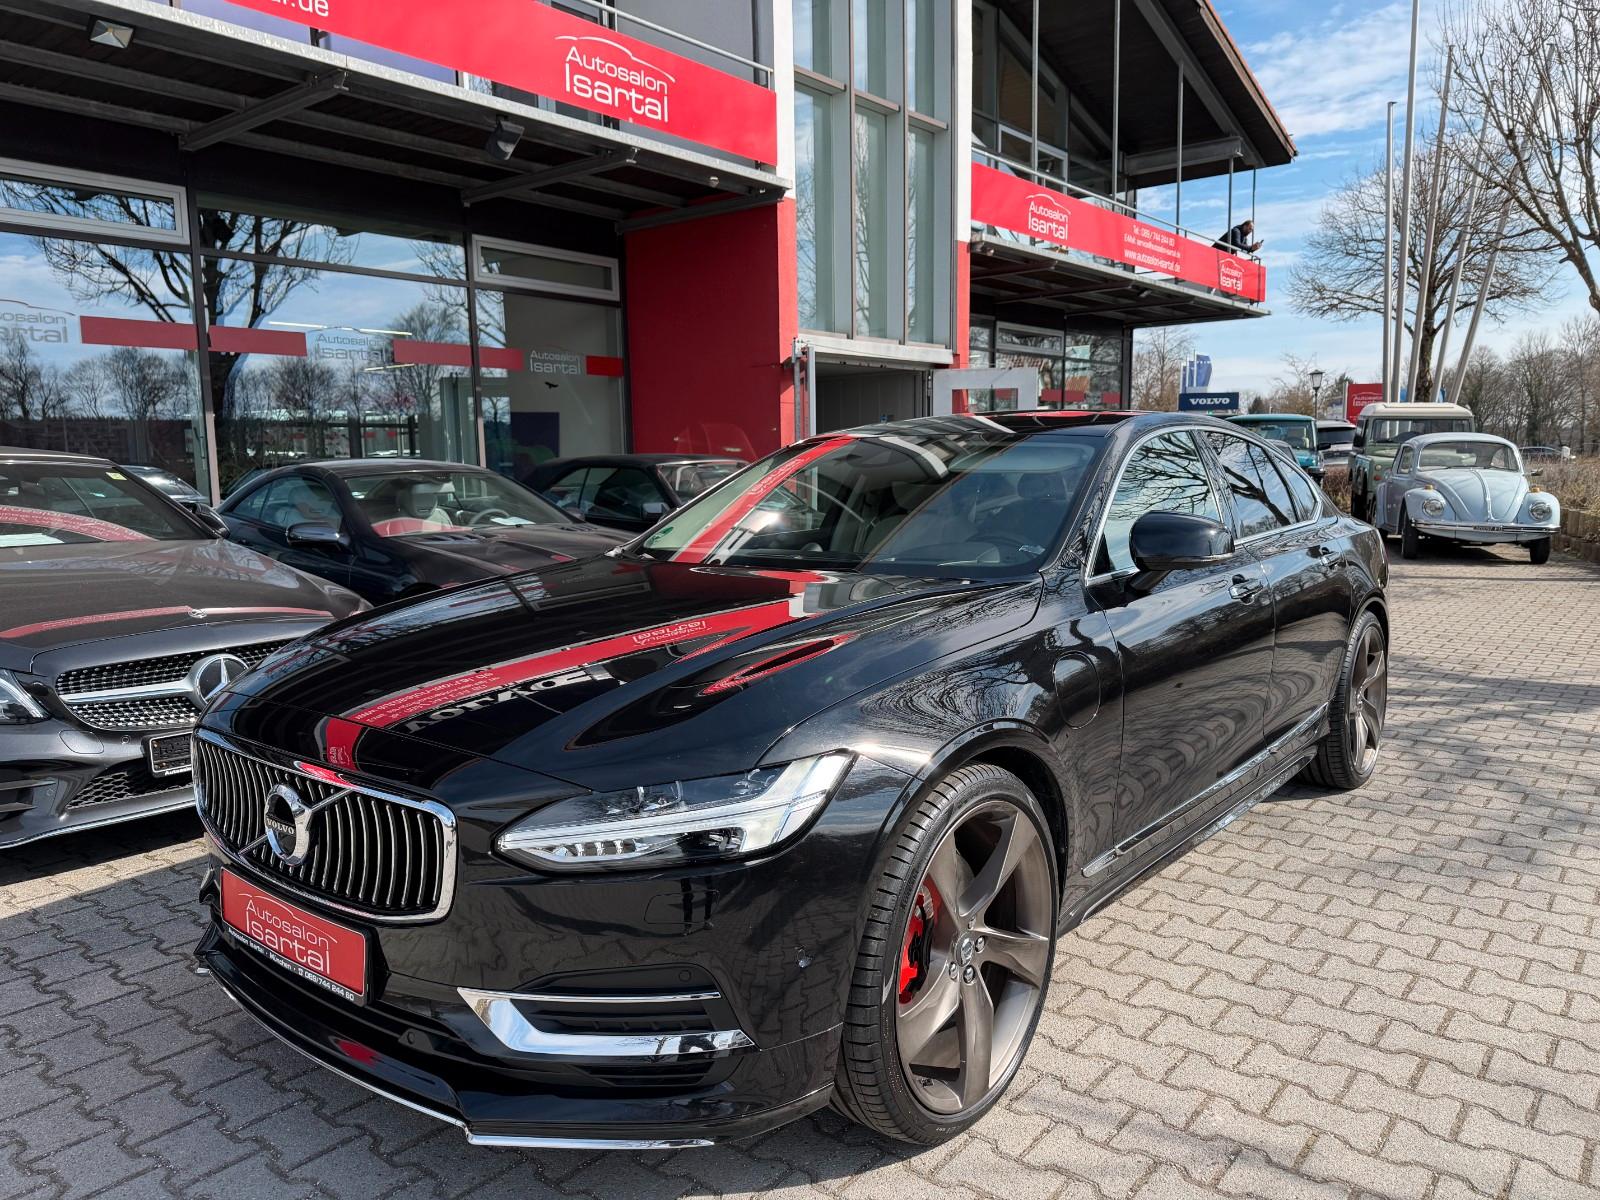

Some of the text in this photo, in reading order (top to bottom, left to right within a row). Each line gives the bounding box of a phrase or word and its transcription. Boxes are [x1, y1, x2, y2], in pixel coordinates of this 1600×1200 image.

[565, 46, 668, 95] Autosalon
[565, 63, 669, 123] Isartal
[1029, 200, 1069, 223] Autosalon
[1028, 211, 1069, 240] Isartal
[530, 350, 580, 362] Autosalon
[530, 358, 581, 375] Isartal
[1189, 397, 1230, 406] VOLVO
[266, 817, 294, 835] VOLVO
[246, 899, 330, 950] Autosalon
[246, 910, 330, 975] Isartal
